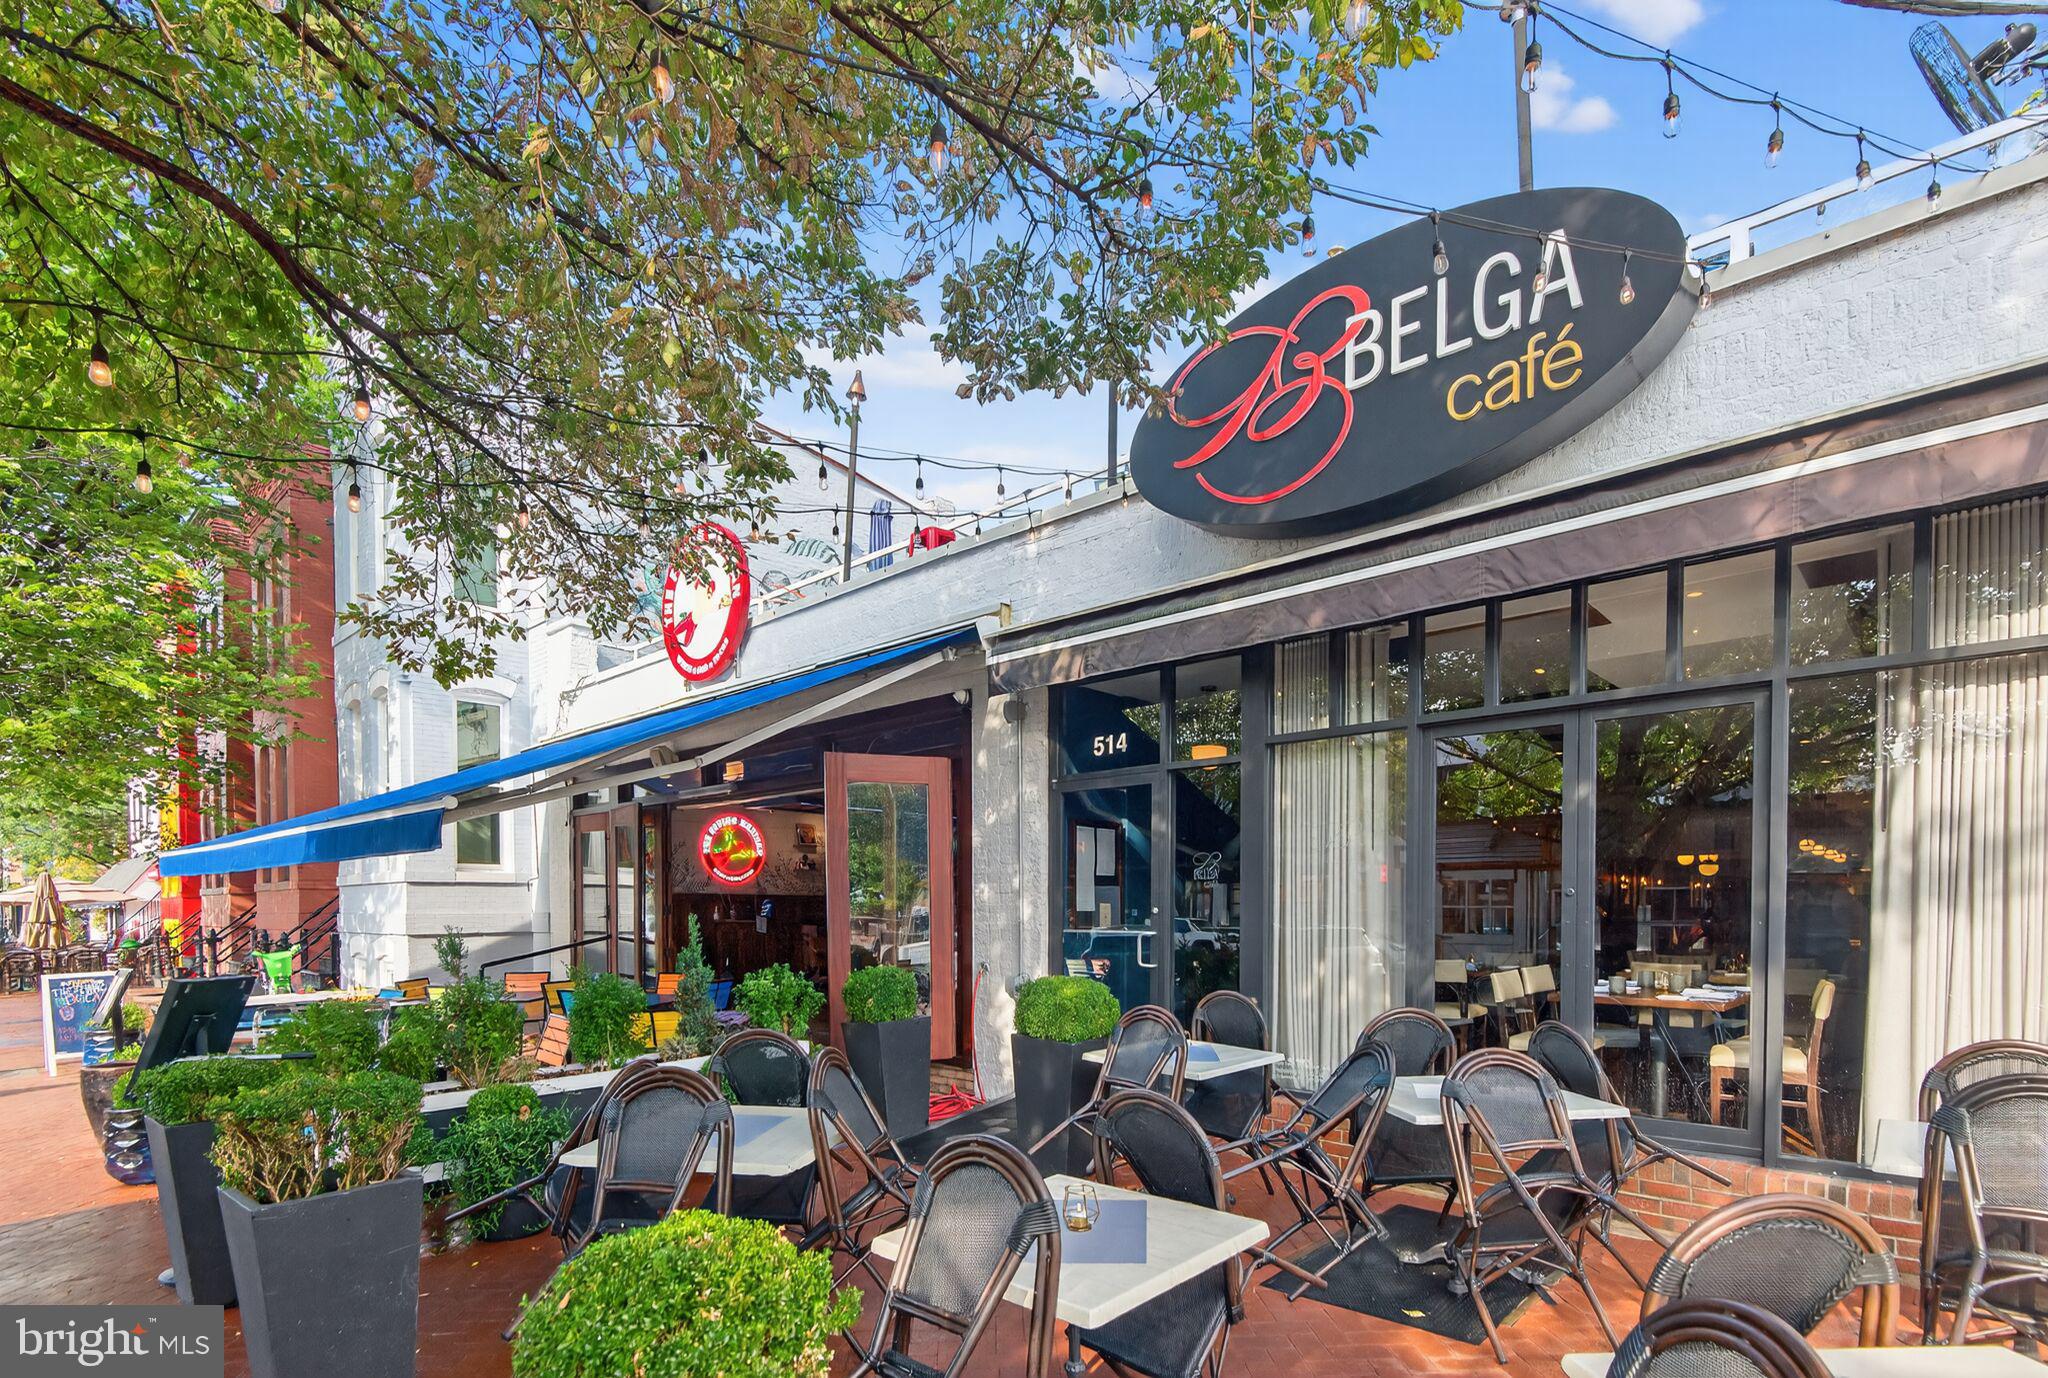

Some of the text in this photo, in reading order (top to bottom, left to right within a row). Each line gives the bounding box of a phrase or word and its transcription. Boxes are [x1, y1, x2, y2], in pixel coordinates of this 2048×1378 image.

[1345, 229, 1584, 391] BELGA
[1446, 322, 1584, 421] café
[1093, 732, 1128, 757] 514
